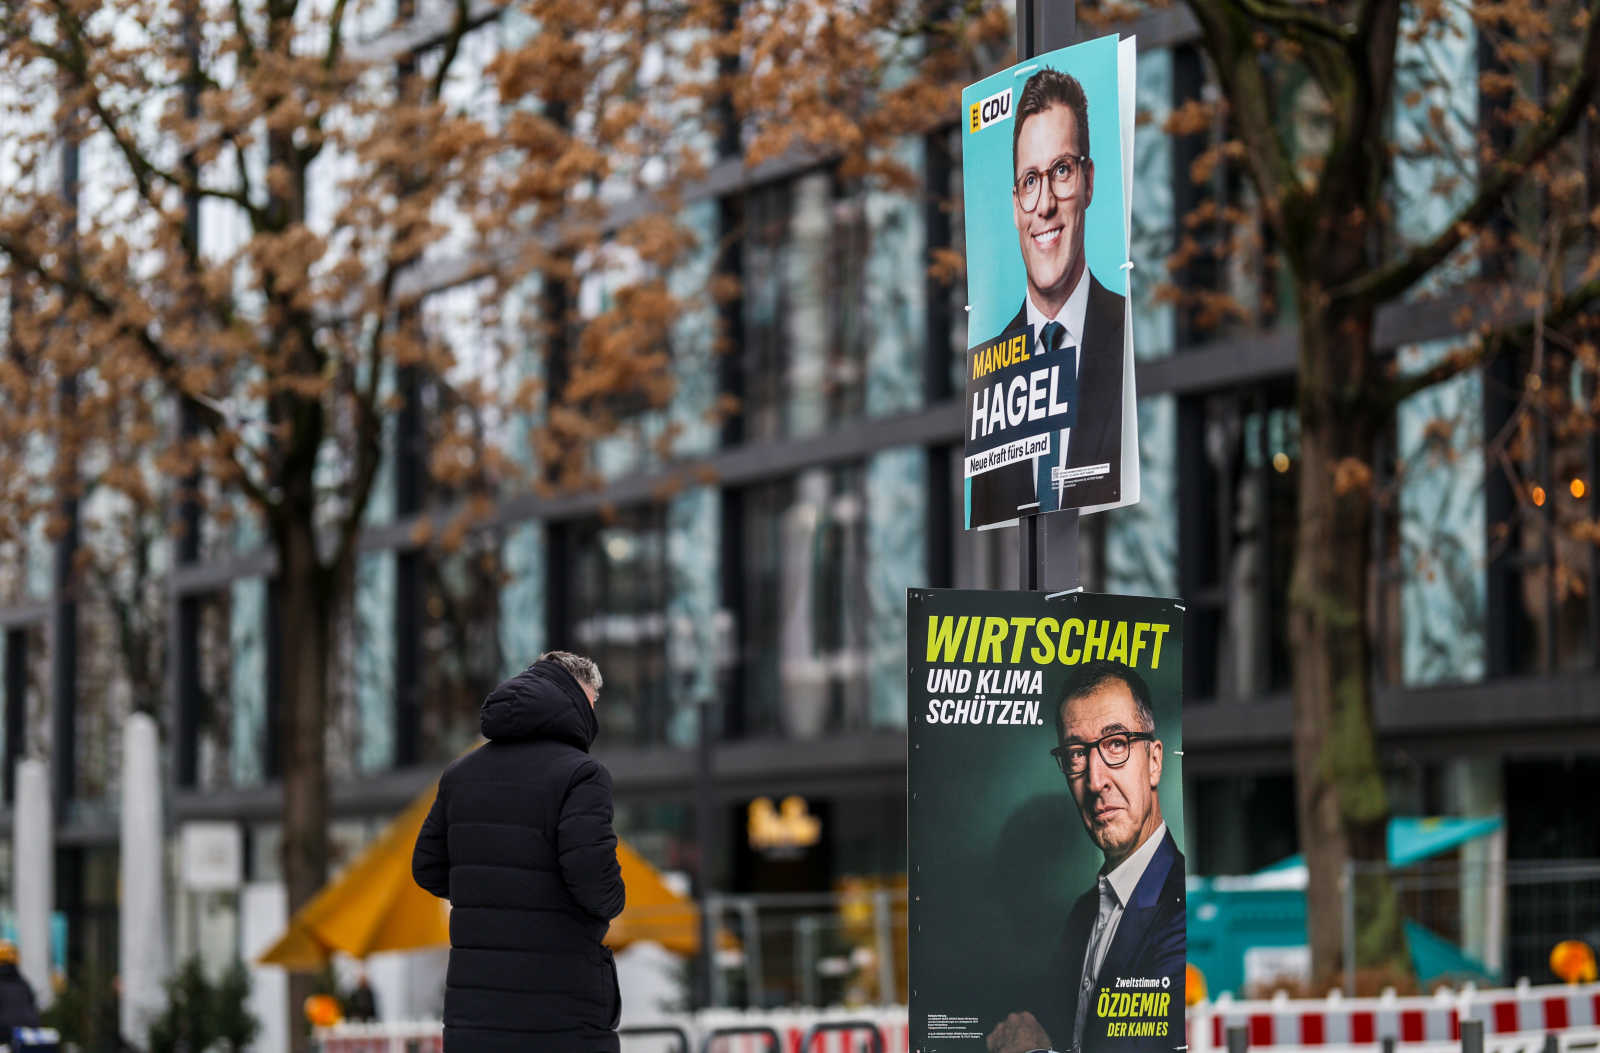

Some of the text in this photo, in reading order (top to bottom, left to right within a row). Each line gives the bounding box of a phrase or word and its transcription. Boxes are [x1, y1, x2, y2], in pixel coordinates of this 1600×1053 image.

[982, 92, 1011, 123] CDU
[972, 334, 1030, 380] MANUEL
[971, 365, 1068, 441] HAGEL
[970, 436, 1047, 473] Neue Kraft fürs Land
[926, 615, 1170, 669] WIRTSCHAFT
[926, 669, 1043, 694] UND KLIMA
[926, 694, 1043, 725] SCHÜTZEN.
[1115, 976, 1160, 988] Zweitstimme
[1097, 987, 1170, 1018] ÖZDEMIR
[1107, 1021, 1169, 1037] DER KANN ES
